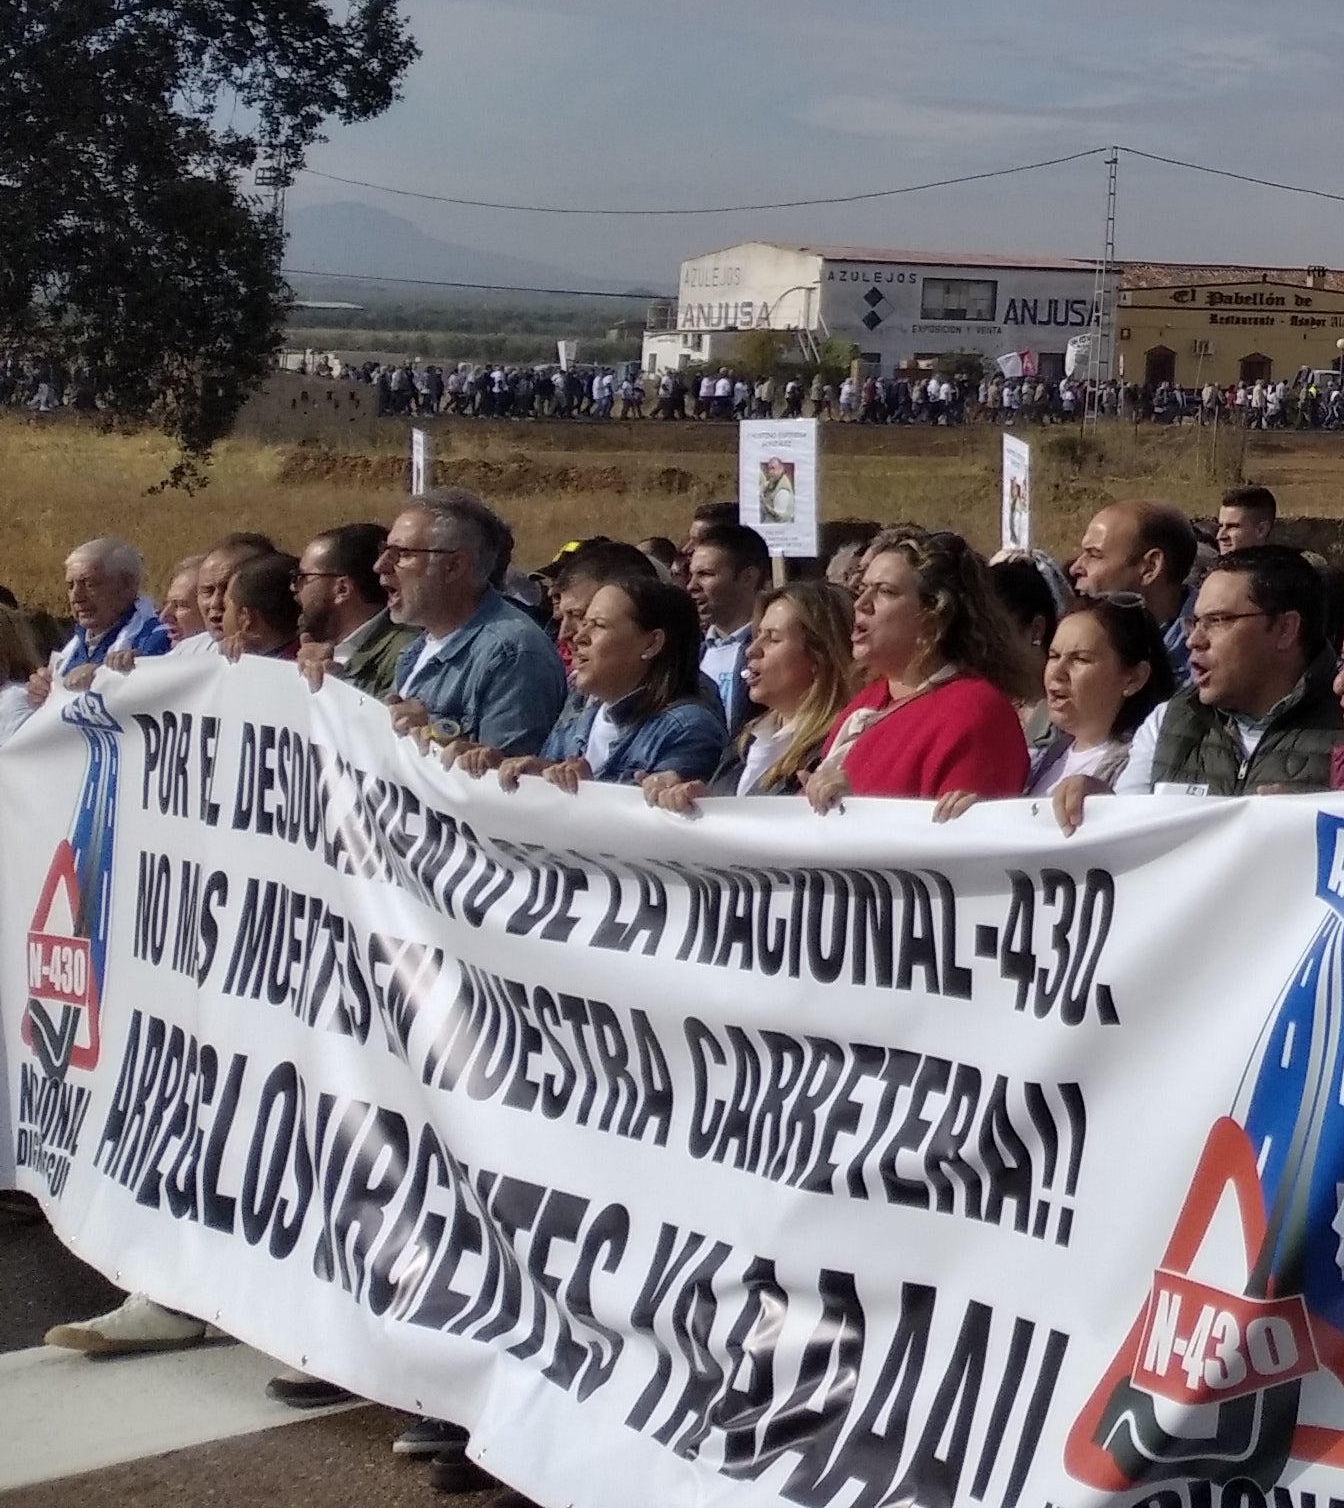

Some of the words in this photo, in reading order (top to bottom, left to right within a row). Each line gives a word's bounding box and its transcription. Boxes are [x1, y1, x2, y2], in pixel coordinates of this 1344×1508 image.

[684, 267, 741, 288] AZULEJOS
[827, 271, 918, 285] AZULEJOS
[1003, 298, 1101, 327] ANJUSA
[1294, 293, 1313, 308] de
[681, 301, 771, 329] ANJUSA
[1208, 313, 1275, 326] Restaurante
[131, 710, 193, 818] POR
[200, 715, 222, 827] EL
[488, 837, 589, 944] DE
[566, 849, 668, 957] LA
[29, 941, 86, 996] N-430
[133, 850, 171, 967] NO
[683, 1016, 1087, 1248] CARRETERA!!
[1143, 1290, 1300, 1391] N-430
